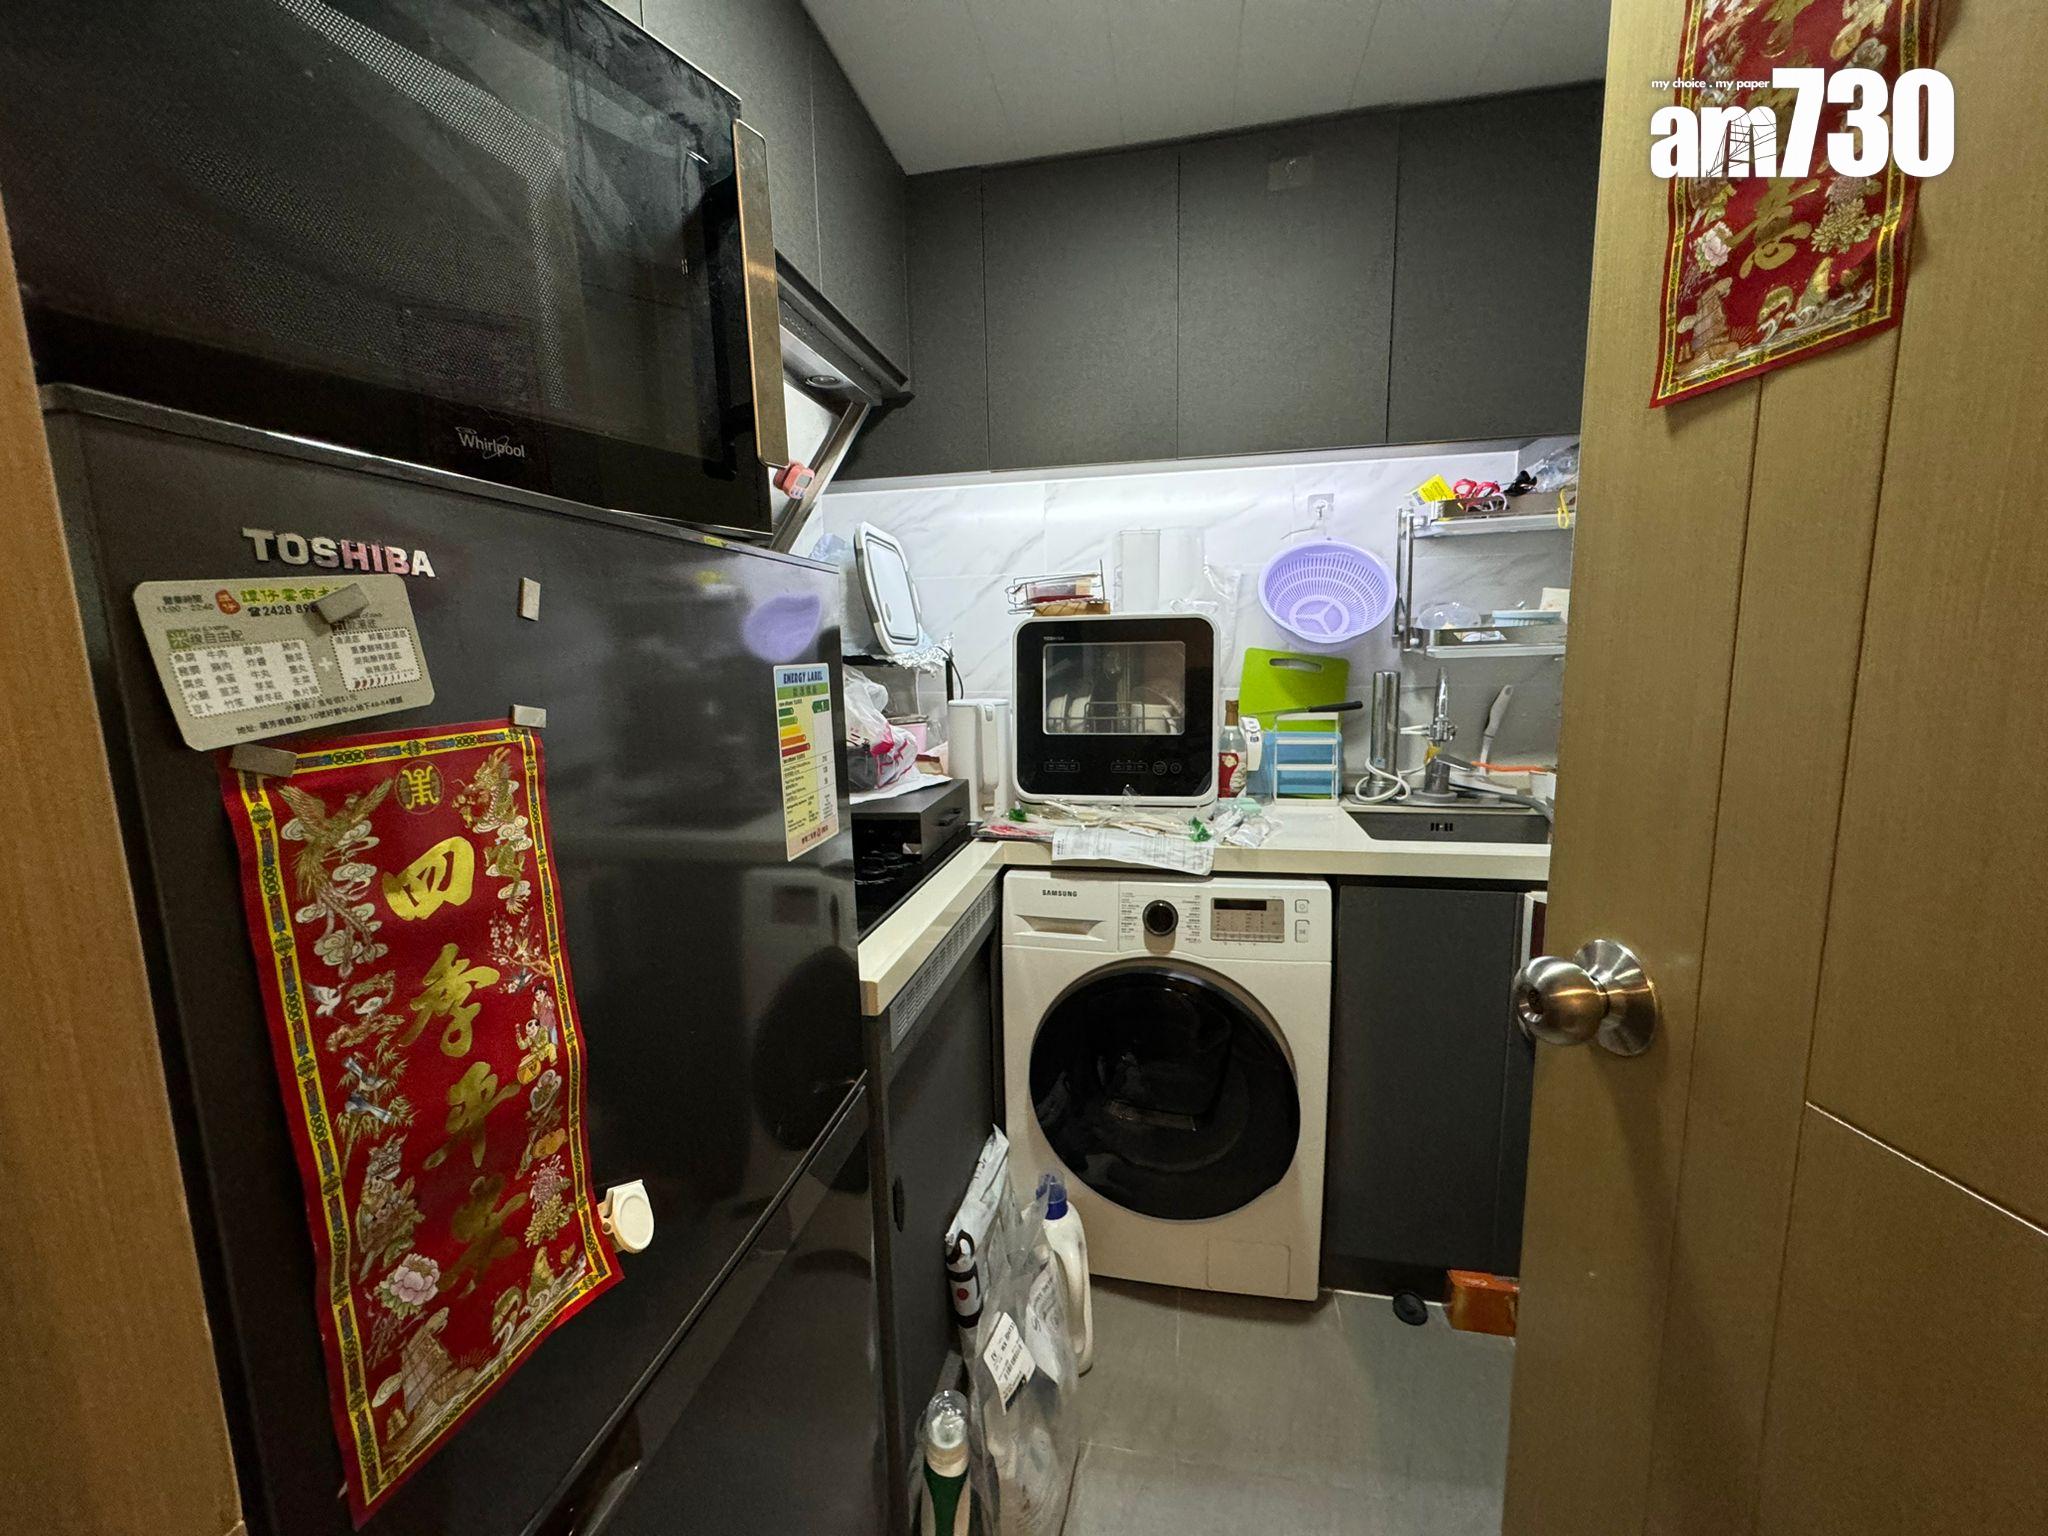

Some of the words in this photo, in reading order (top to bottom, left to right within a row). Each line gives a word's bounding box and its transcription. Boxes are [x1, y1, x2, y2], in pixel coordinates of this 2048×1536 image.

[457, 430, 526, 459] Whirlpool
[241, 527, 436, 578] TOSHIBA
[263, 605, 292, 617] 2428
[783, 672, 806, 685] ENERGY
[1042, 889, 1078, 898] SAMSUNG
